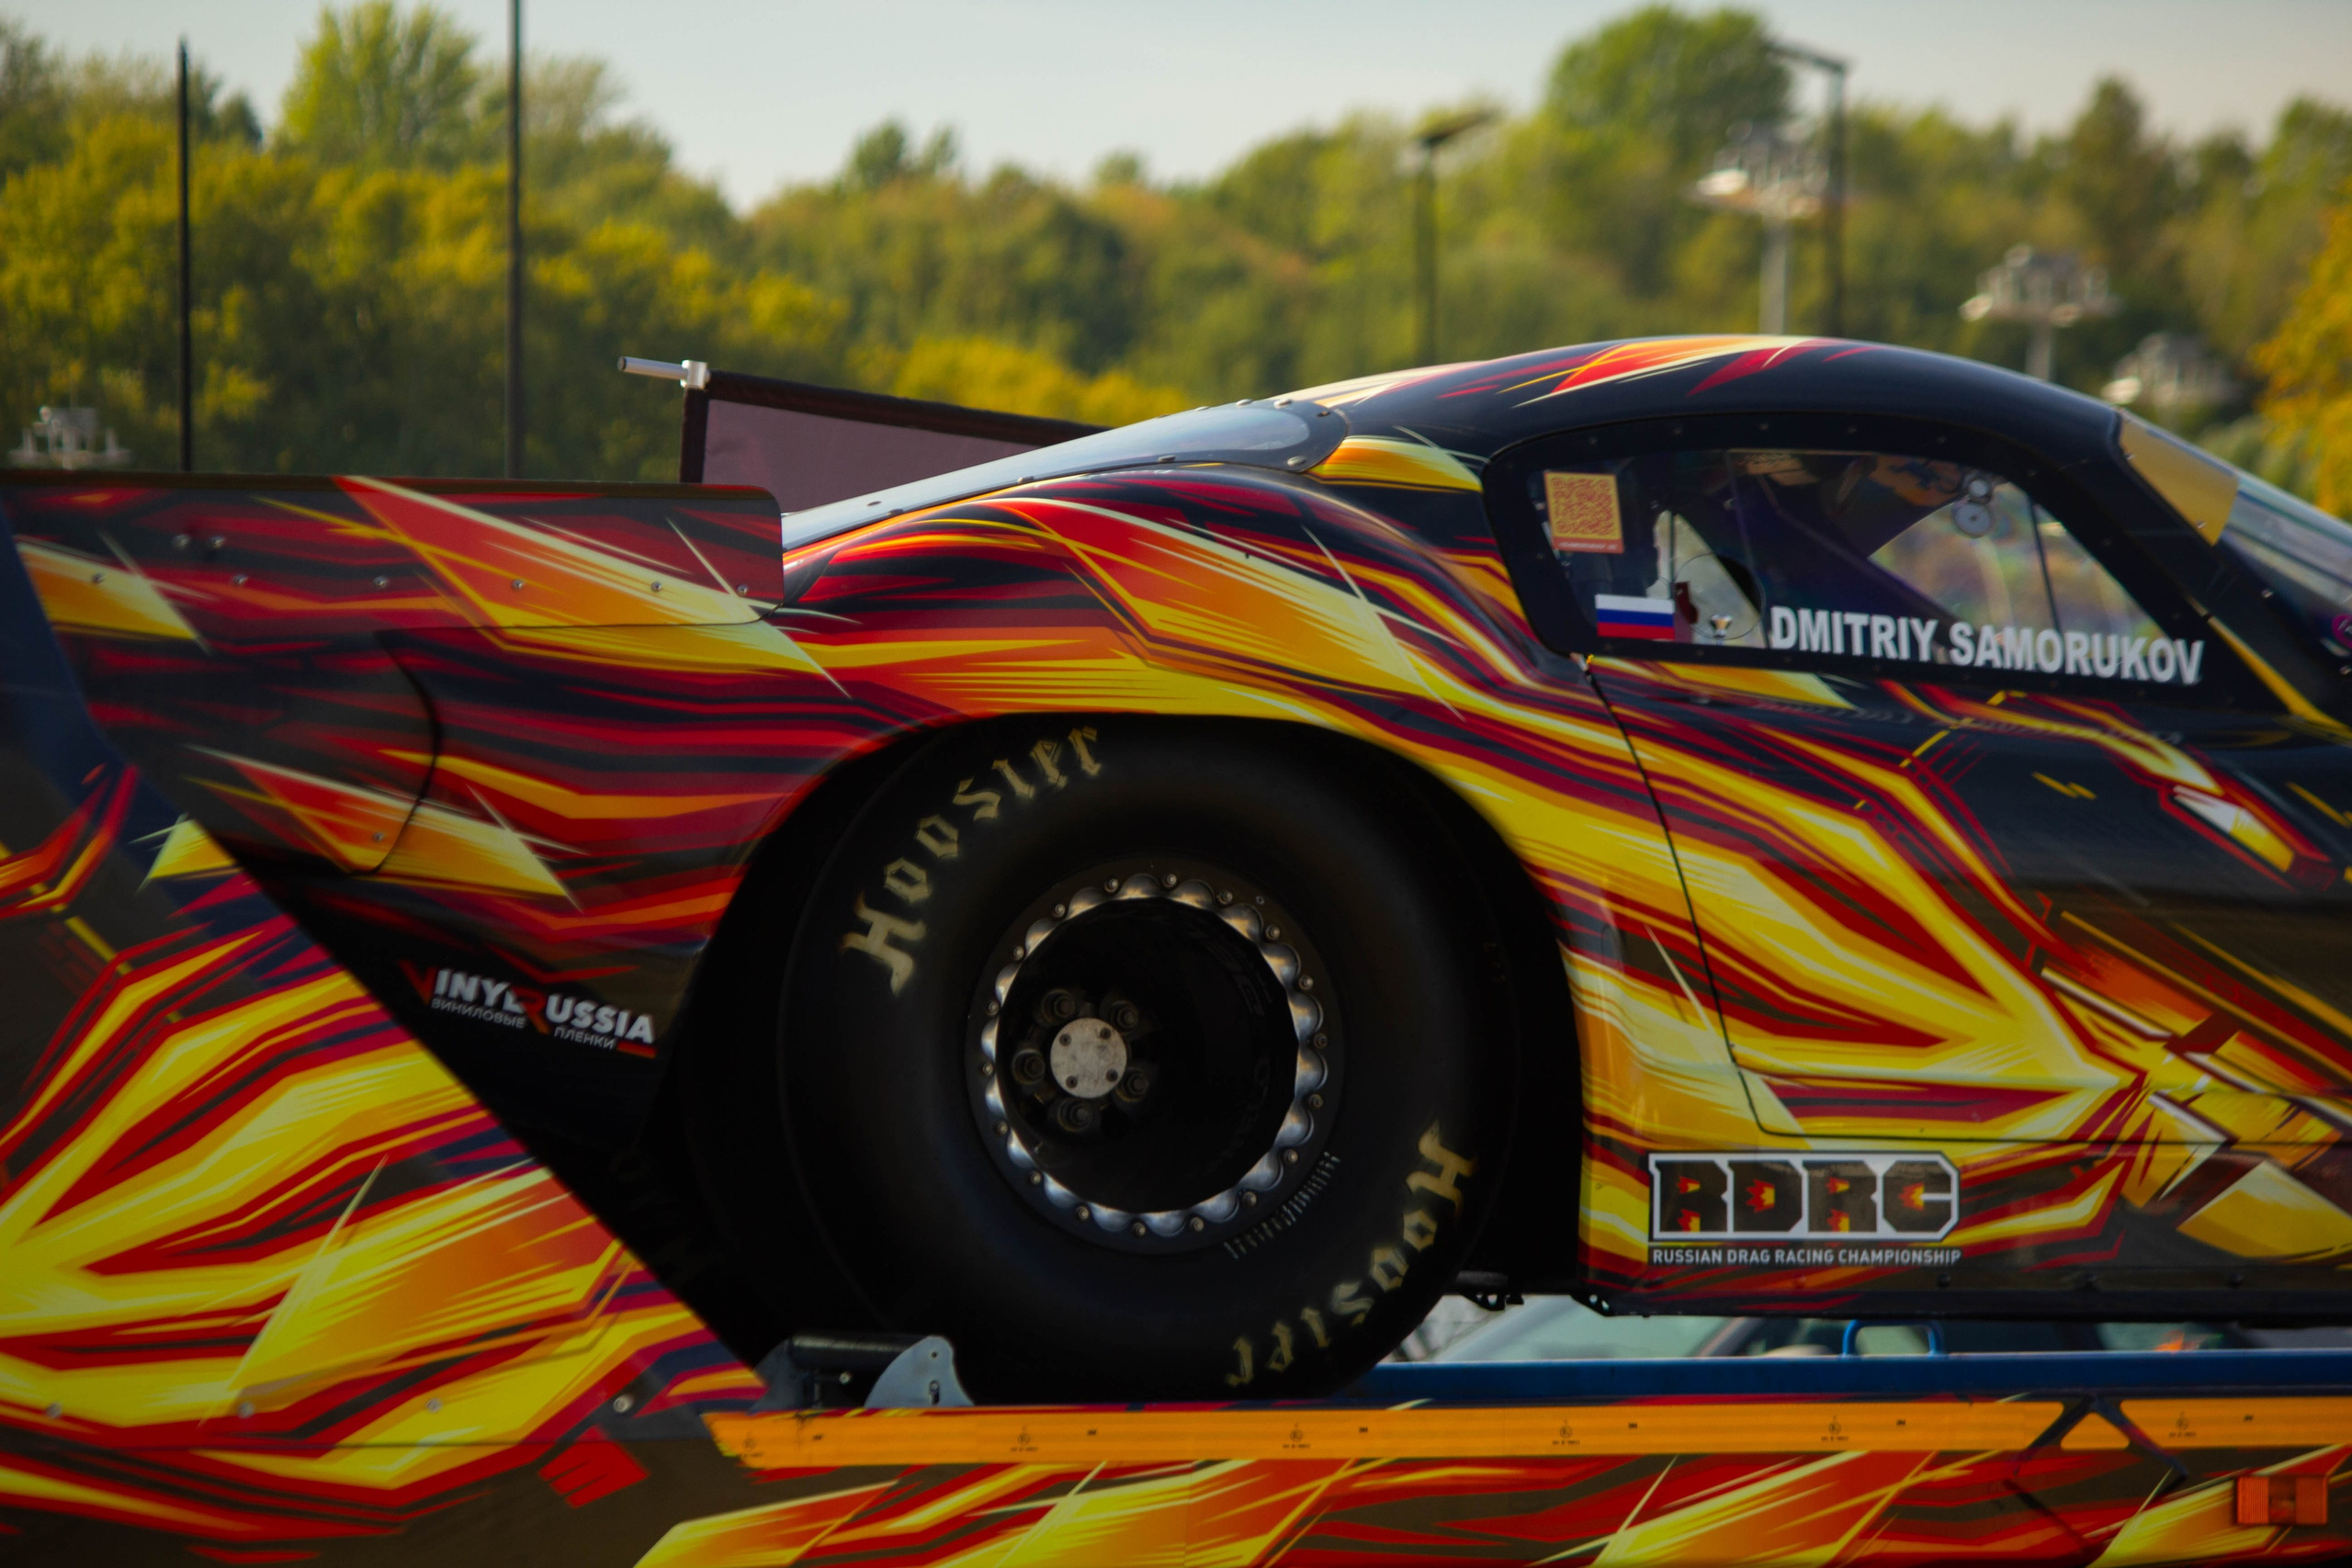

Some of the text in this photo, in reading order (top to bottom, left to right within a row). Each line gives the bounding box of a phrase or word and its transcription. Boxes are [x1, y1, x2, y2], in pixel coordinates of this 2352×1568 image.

[1770, 606, 2204, 686] DMITRIY SAMORUKOV
[431, 998, 616, 1051] ВИНИЛОВЫЕ ПЛЕНКИ
[1648, 1152, 1961, 1242] RDRC
[1653, 1247, 1962, 1266] RUSSIAN DRAG RACING CHAMPIONSHIP
